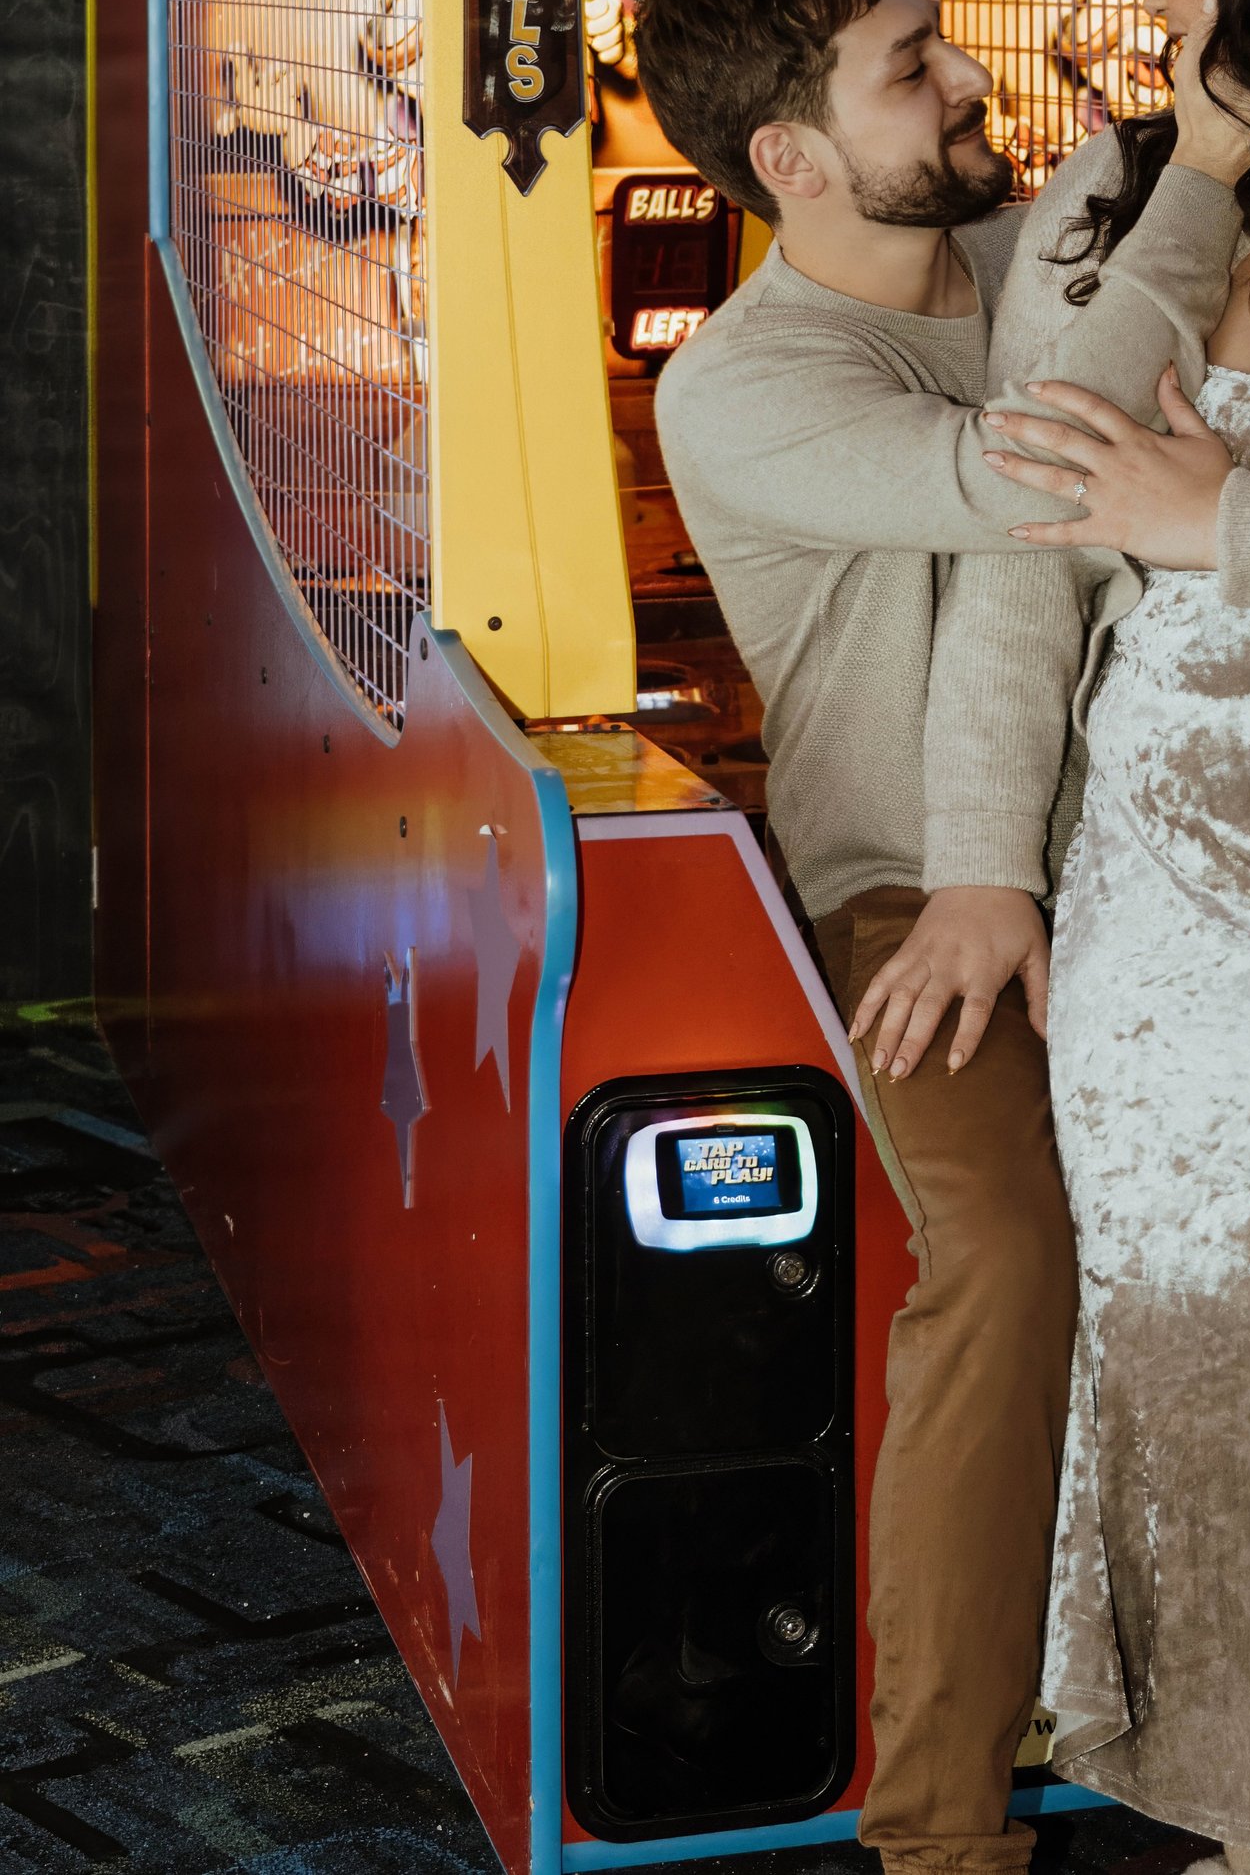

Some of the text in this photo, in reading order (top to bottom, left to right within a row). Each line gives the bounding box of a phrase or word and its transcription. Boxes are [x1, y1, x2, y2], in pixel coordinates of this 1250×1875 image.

[627, 187, 717, 222] BALLS
[634, 309, 707, 348] LEFT
[699, 1140, 744, 1159] TAP
[684, 1155, 758, 1172] CARD TO
[711, 1167, 774, 1185] PLAY!
[721, 1194, 750, 1204] Credits
